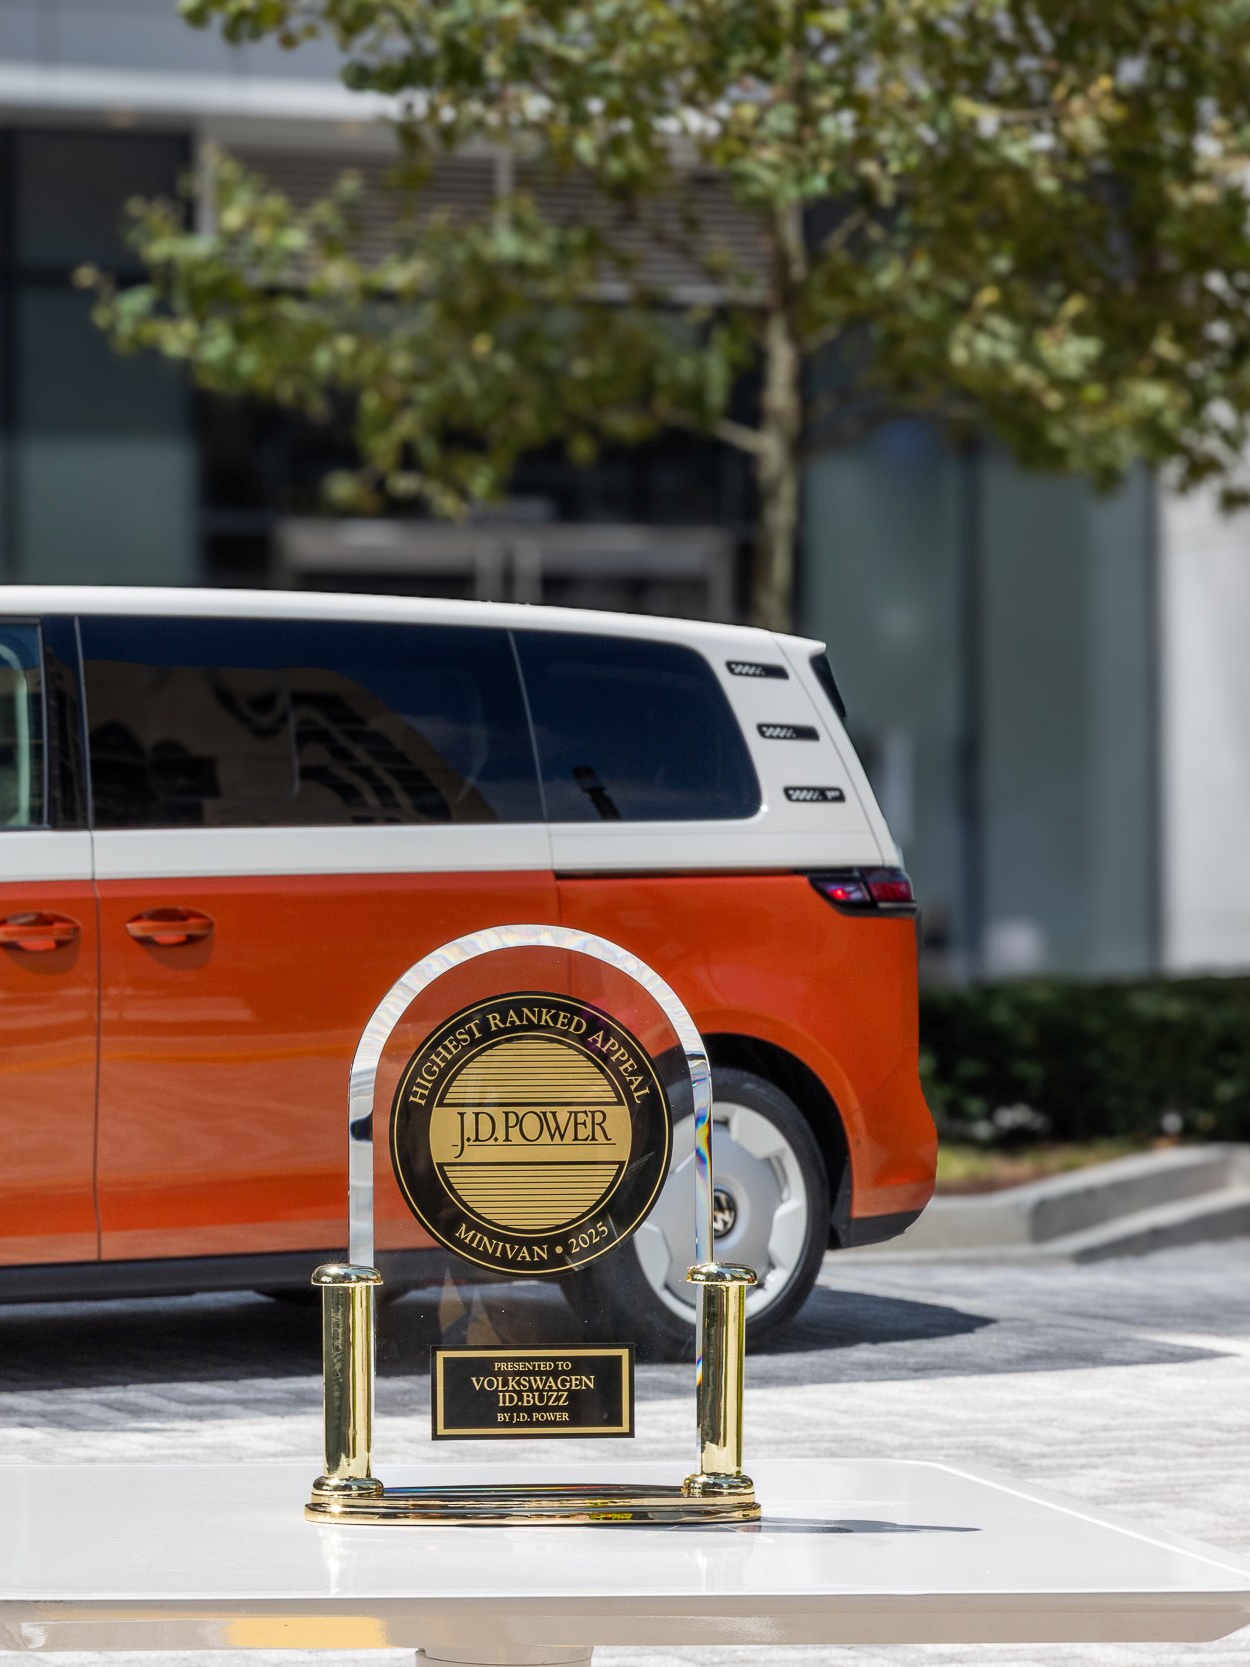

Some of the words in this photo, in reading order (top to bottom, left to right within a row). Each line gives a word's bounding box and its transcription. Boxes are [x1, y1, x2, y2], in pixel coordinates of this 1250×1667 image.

[408, 1019, 481, 1107] HIGHEST
[486, 1007, 587, 1036] RANKED
[587, 1029, 651, 1104] APPEAL
[454, 1222, 549, 1262] MINIVAN
[567, 1220, 610, 1255] 2025
[494, 1361, 554, 1372] PRESENTED
[555, 1361, 572, 1371] TO
[470, 1375, 595, 1391] VOLKSWAGEN
[497, 1391, 569, 1407] ID.BUZZ
[496, 1412, 511, 1422] BY
[512, 1412, 530, 1424] J.D.
[532, 1411, 570, 1422] POWER
